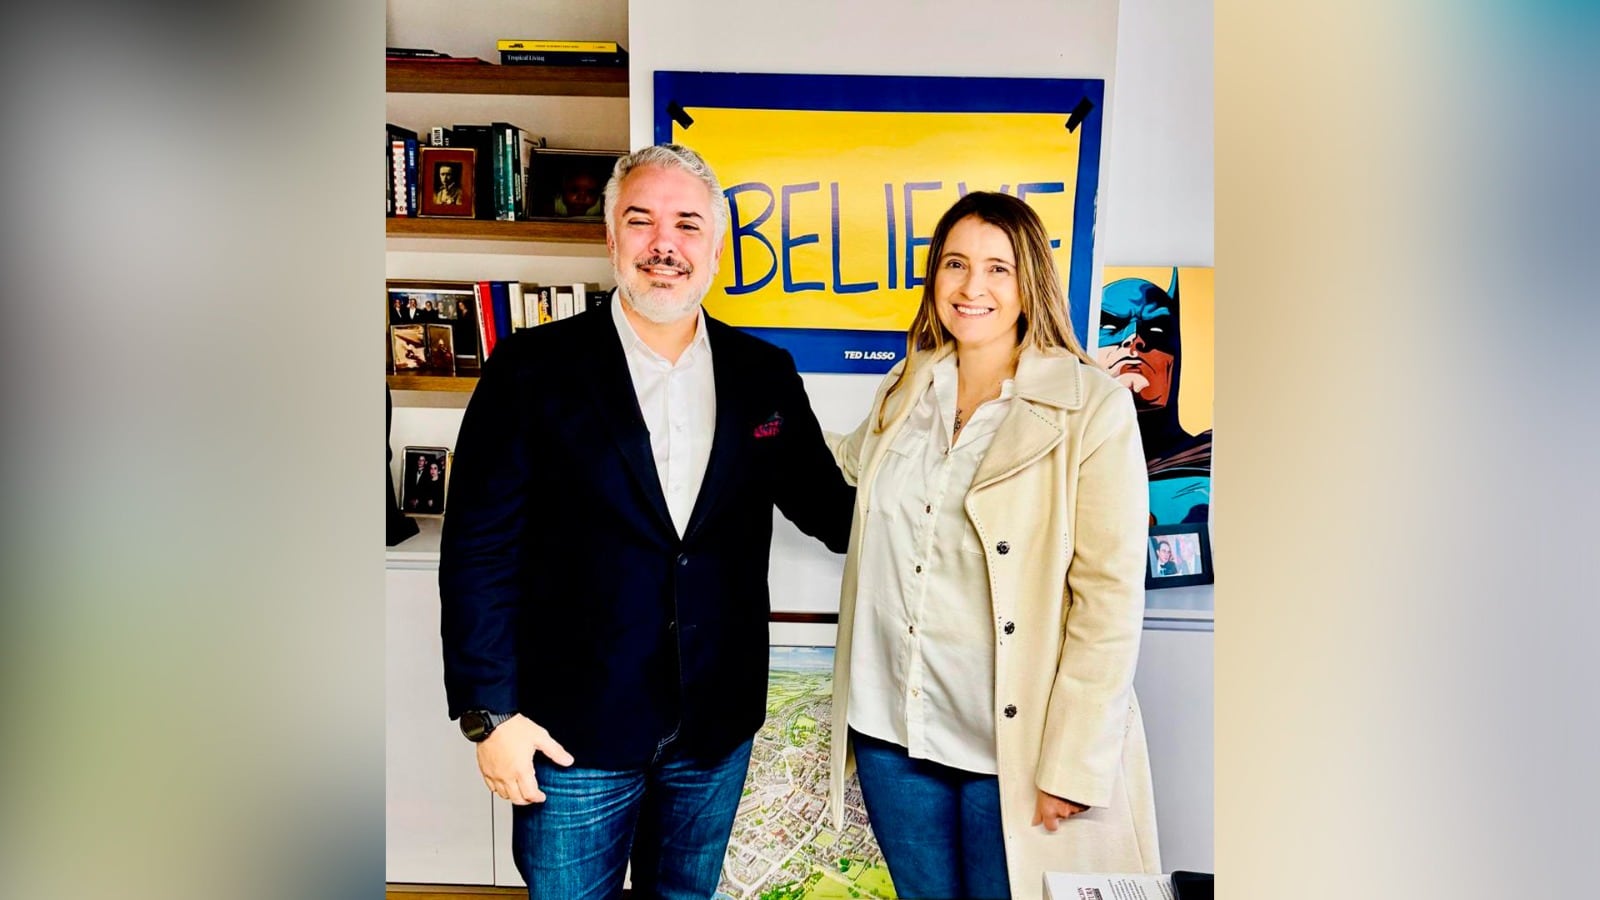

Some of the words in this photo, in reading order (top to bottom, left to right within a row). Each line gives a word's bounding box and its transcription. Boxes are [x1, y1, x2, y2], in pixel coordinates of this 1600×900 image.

[723, 182, 1064, 295] BELIE
[844, 350, 863, 360] TED
[863, 351, 896, 361] LASSO
